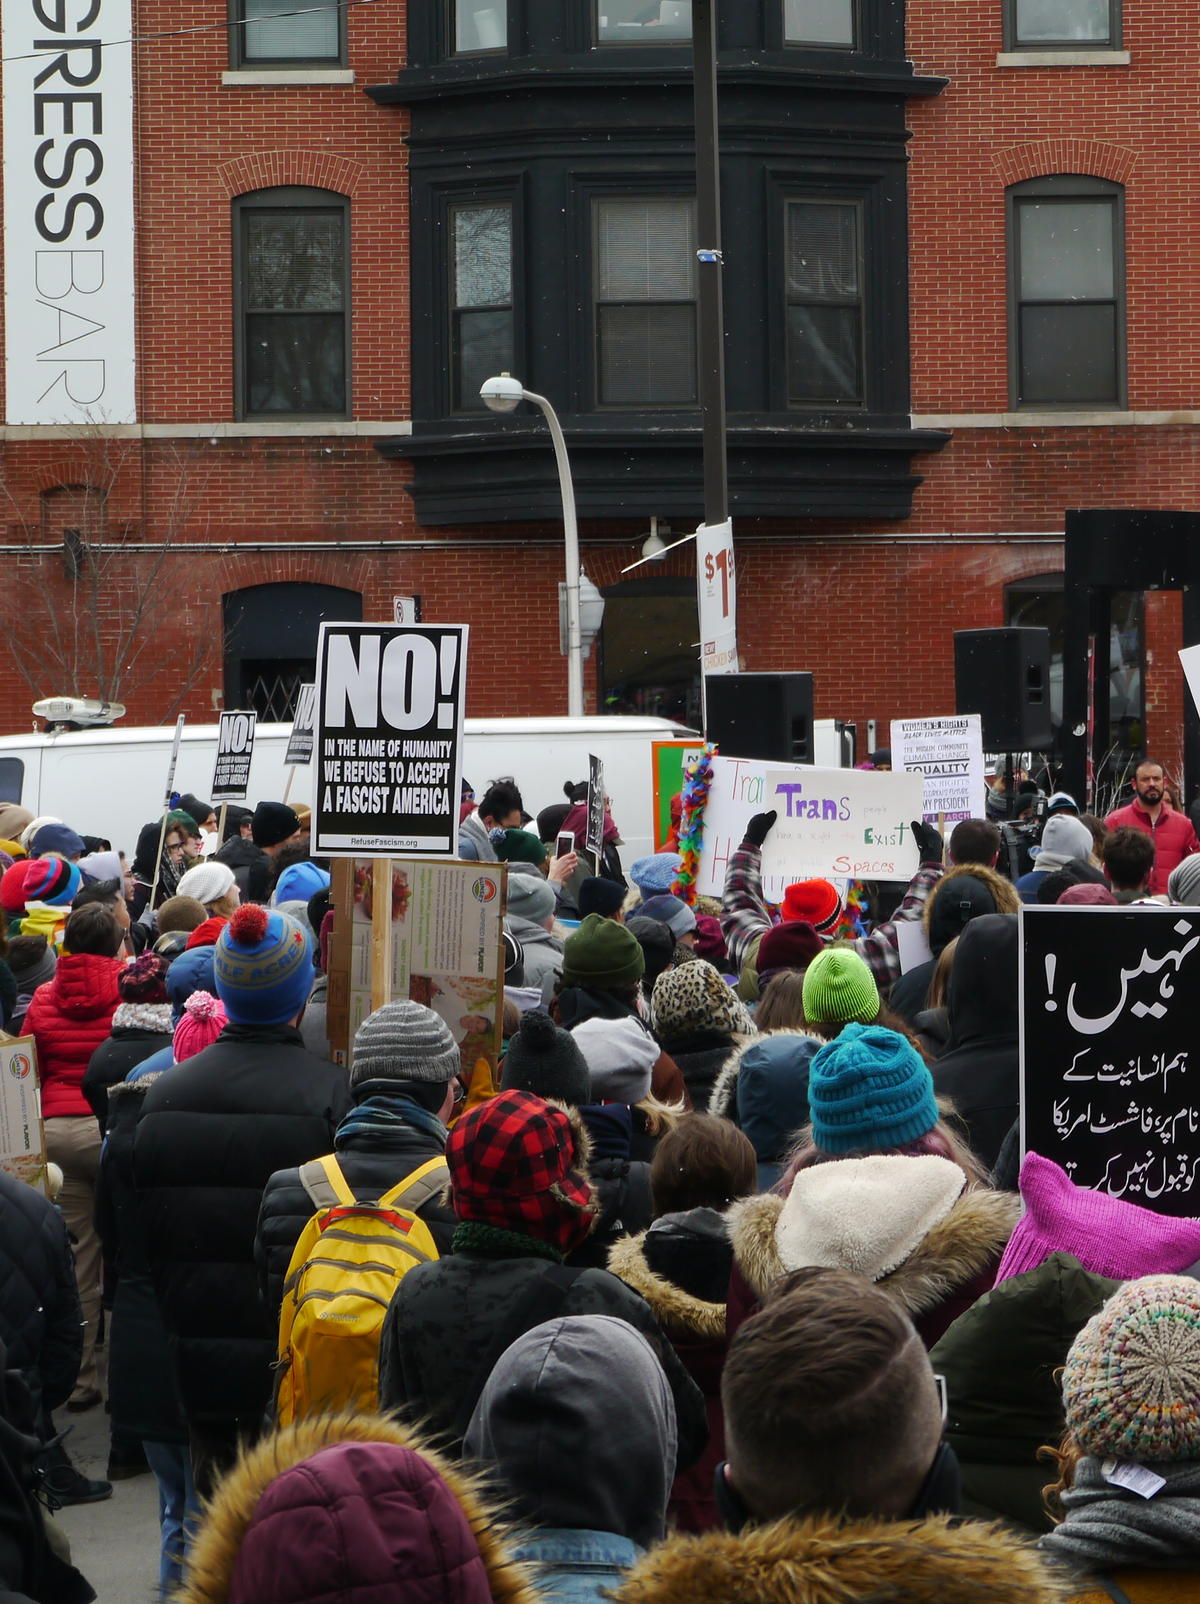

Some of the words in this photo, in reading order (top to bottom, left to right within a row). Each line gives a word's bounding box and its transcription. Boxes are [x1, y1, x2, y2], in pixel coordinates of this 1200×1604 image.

[325, 634, 458, 730] NO!
[219, 715, 255, 753] NO!
[325, 739, 335, 757] IN
[337, 739, 356, 757] THE
[358, 739, 386, 757] NAME
[387, 739, 401, 758] OF
[402, 741, 452, 759] HUMANITY
[324, 761, 340, 783] WE
[343, 761, 387, 784] REFUSE
[389, 762, 405, 784] TO
[407, 763, 450, 785] ACCEPT
[322, 786, 332, 813] A
[336, 786, 390, 814] FASCIST
[392, 787, 450, 815] AMERICA
[775, 783, 851, 821] Trans
[934, 797, 969, 810] PRESIDENT
[943, 812, 970, 821] ARCH
[351, 837, 418, 849] RefuseFascism.org
